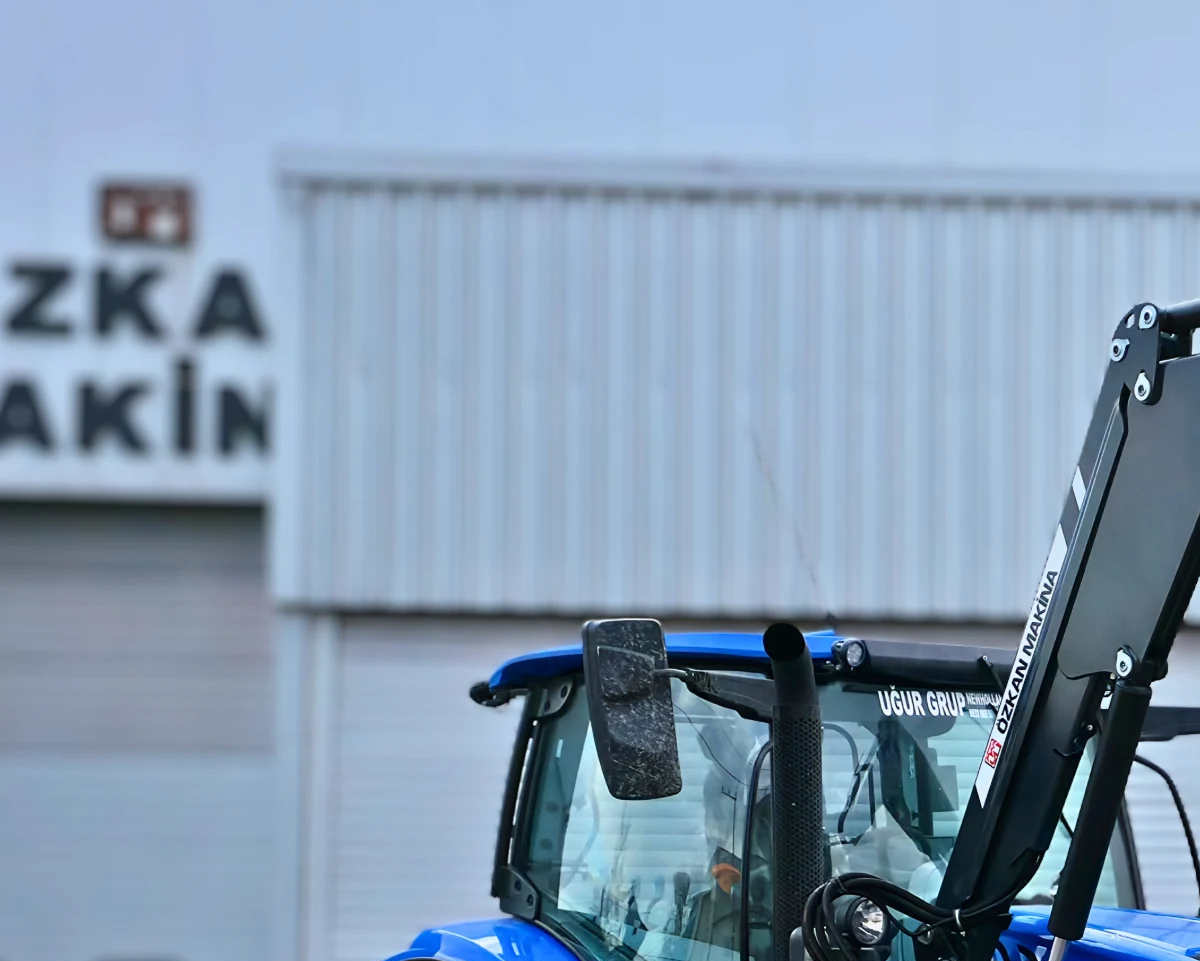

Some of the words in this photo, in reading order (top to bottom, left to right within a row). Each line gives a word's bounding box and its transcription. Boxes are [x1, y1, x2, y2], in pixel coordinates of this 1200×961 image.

[877, 684, 926, 716] UĞUR
[926, 691, 966, 717] GRUP
[996, 658, 1028, 734] ÖZKAN
[1022, 570, 1058, 657] MAKİNA
